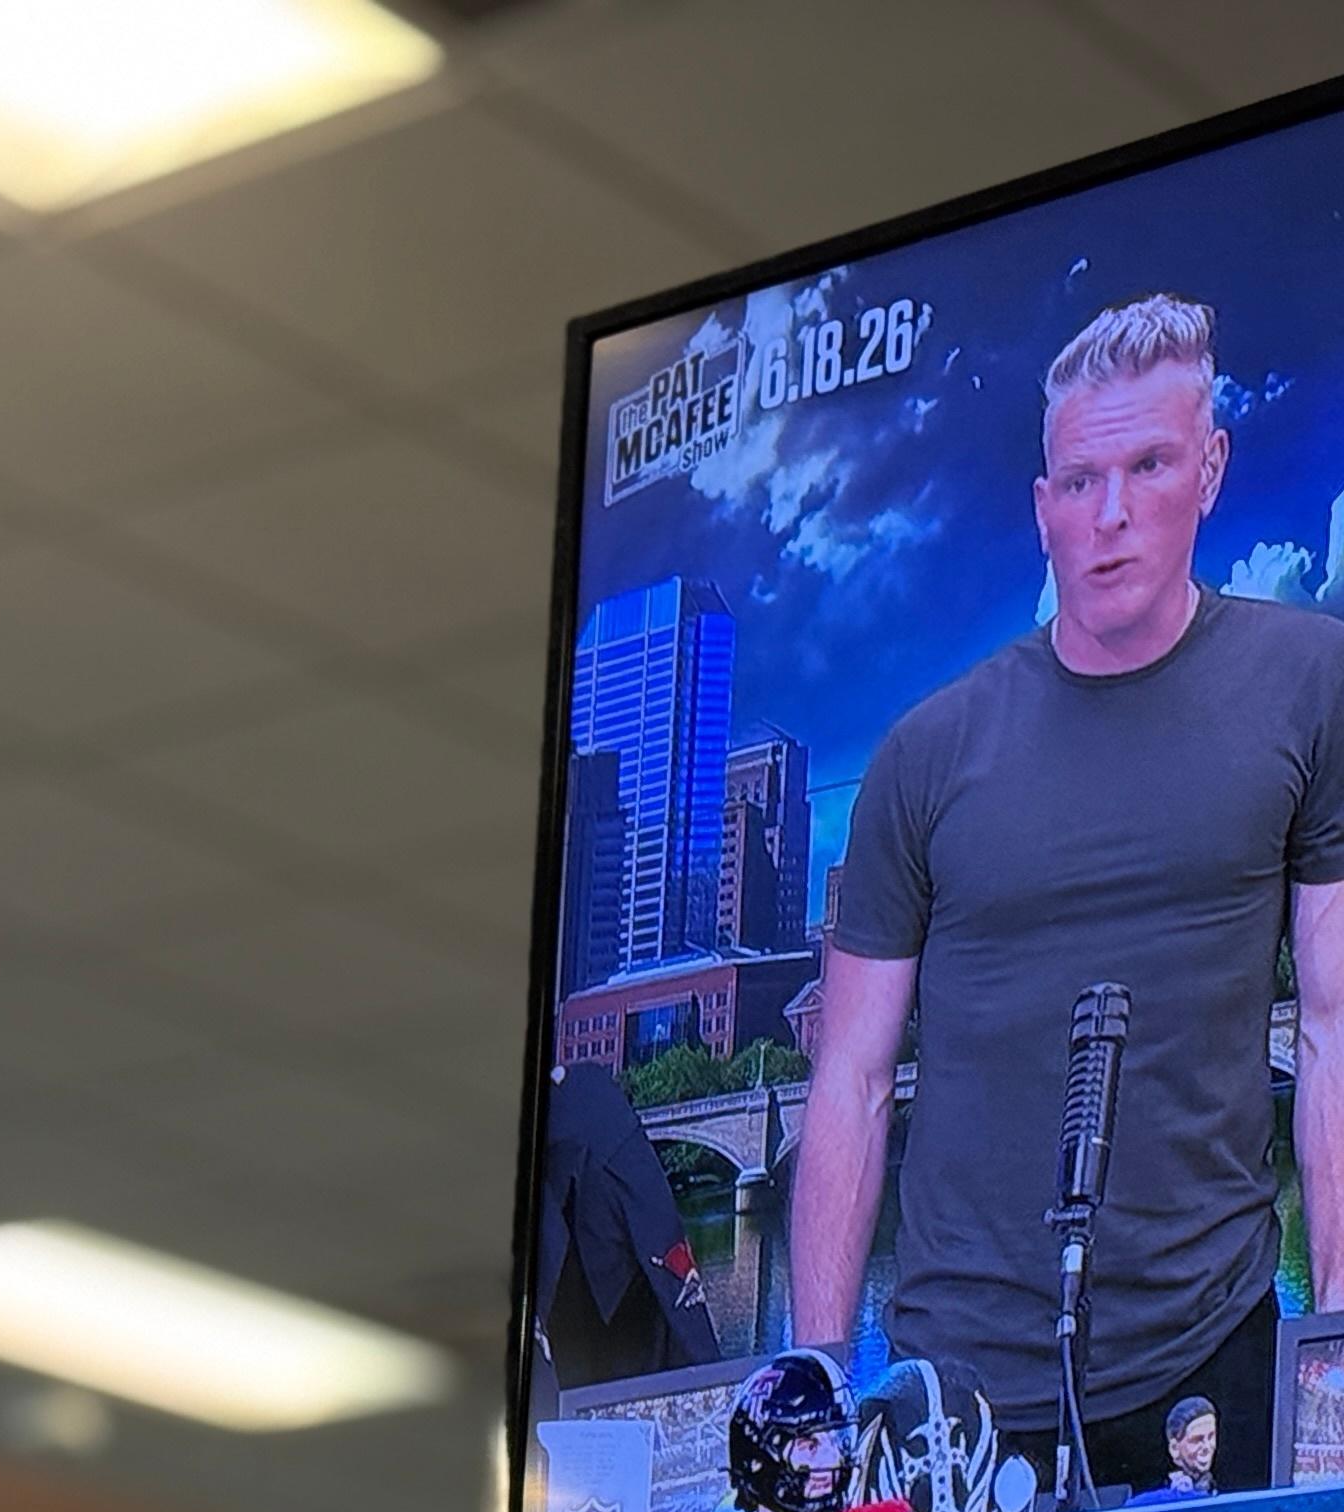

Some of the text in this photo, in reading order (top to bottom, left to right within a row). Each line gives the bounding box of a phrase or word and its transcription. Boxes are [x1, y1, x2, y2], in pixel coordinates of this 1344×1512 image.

[651, 351, 706, 417] PAT
[759, 299, 914, 409] 6.18.26
[615, 377, 734, 481] MCAFEE
[682, 430, 730, 470] show
